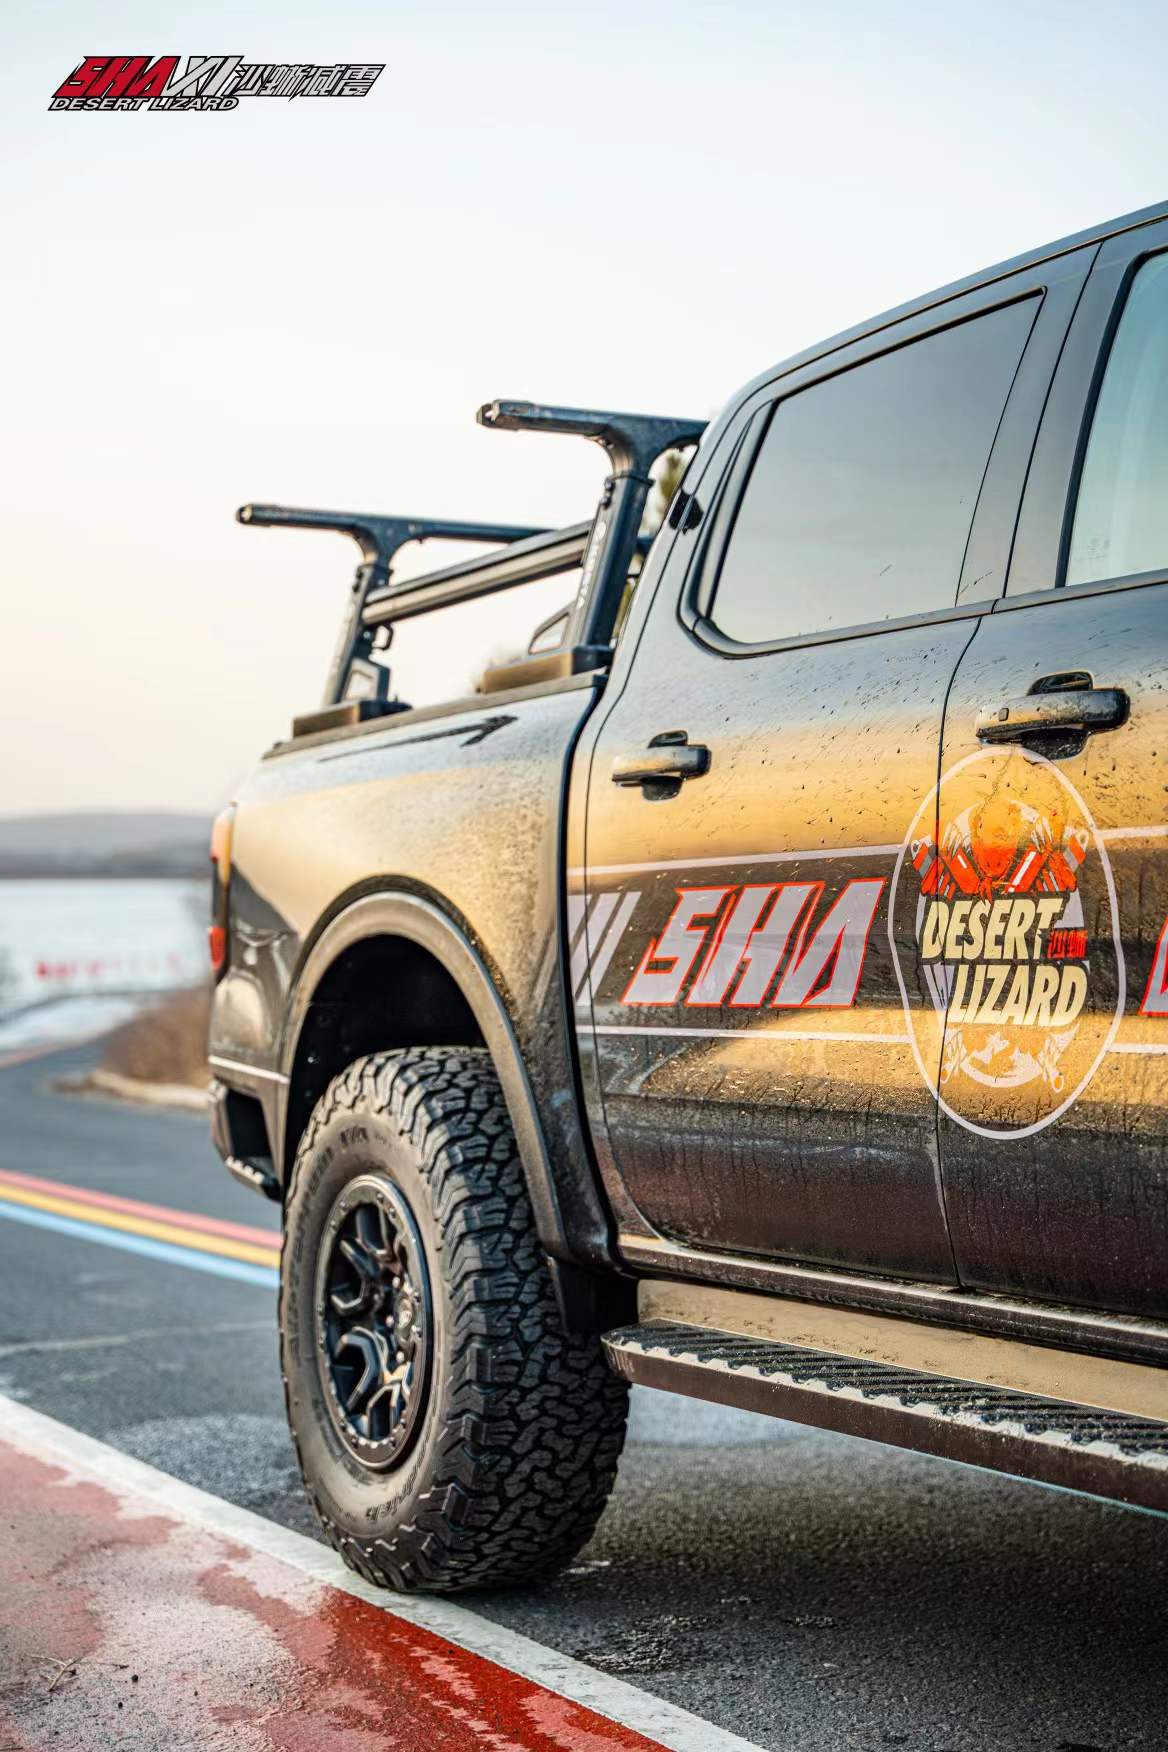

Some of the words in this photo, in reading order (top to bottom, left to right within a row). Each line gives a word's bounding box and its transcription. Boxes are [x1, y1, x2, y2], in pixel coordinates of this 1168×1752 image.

[620, 877, 888, 1008] SHA
[922, 898, 1064, 960] DESERT
[946, 964, 1088, 1027] LIZARD
